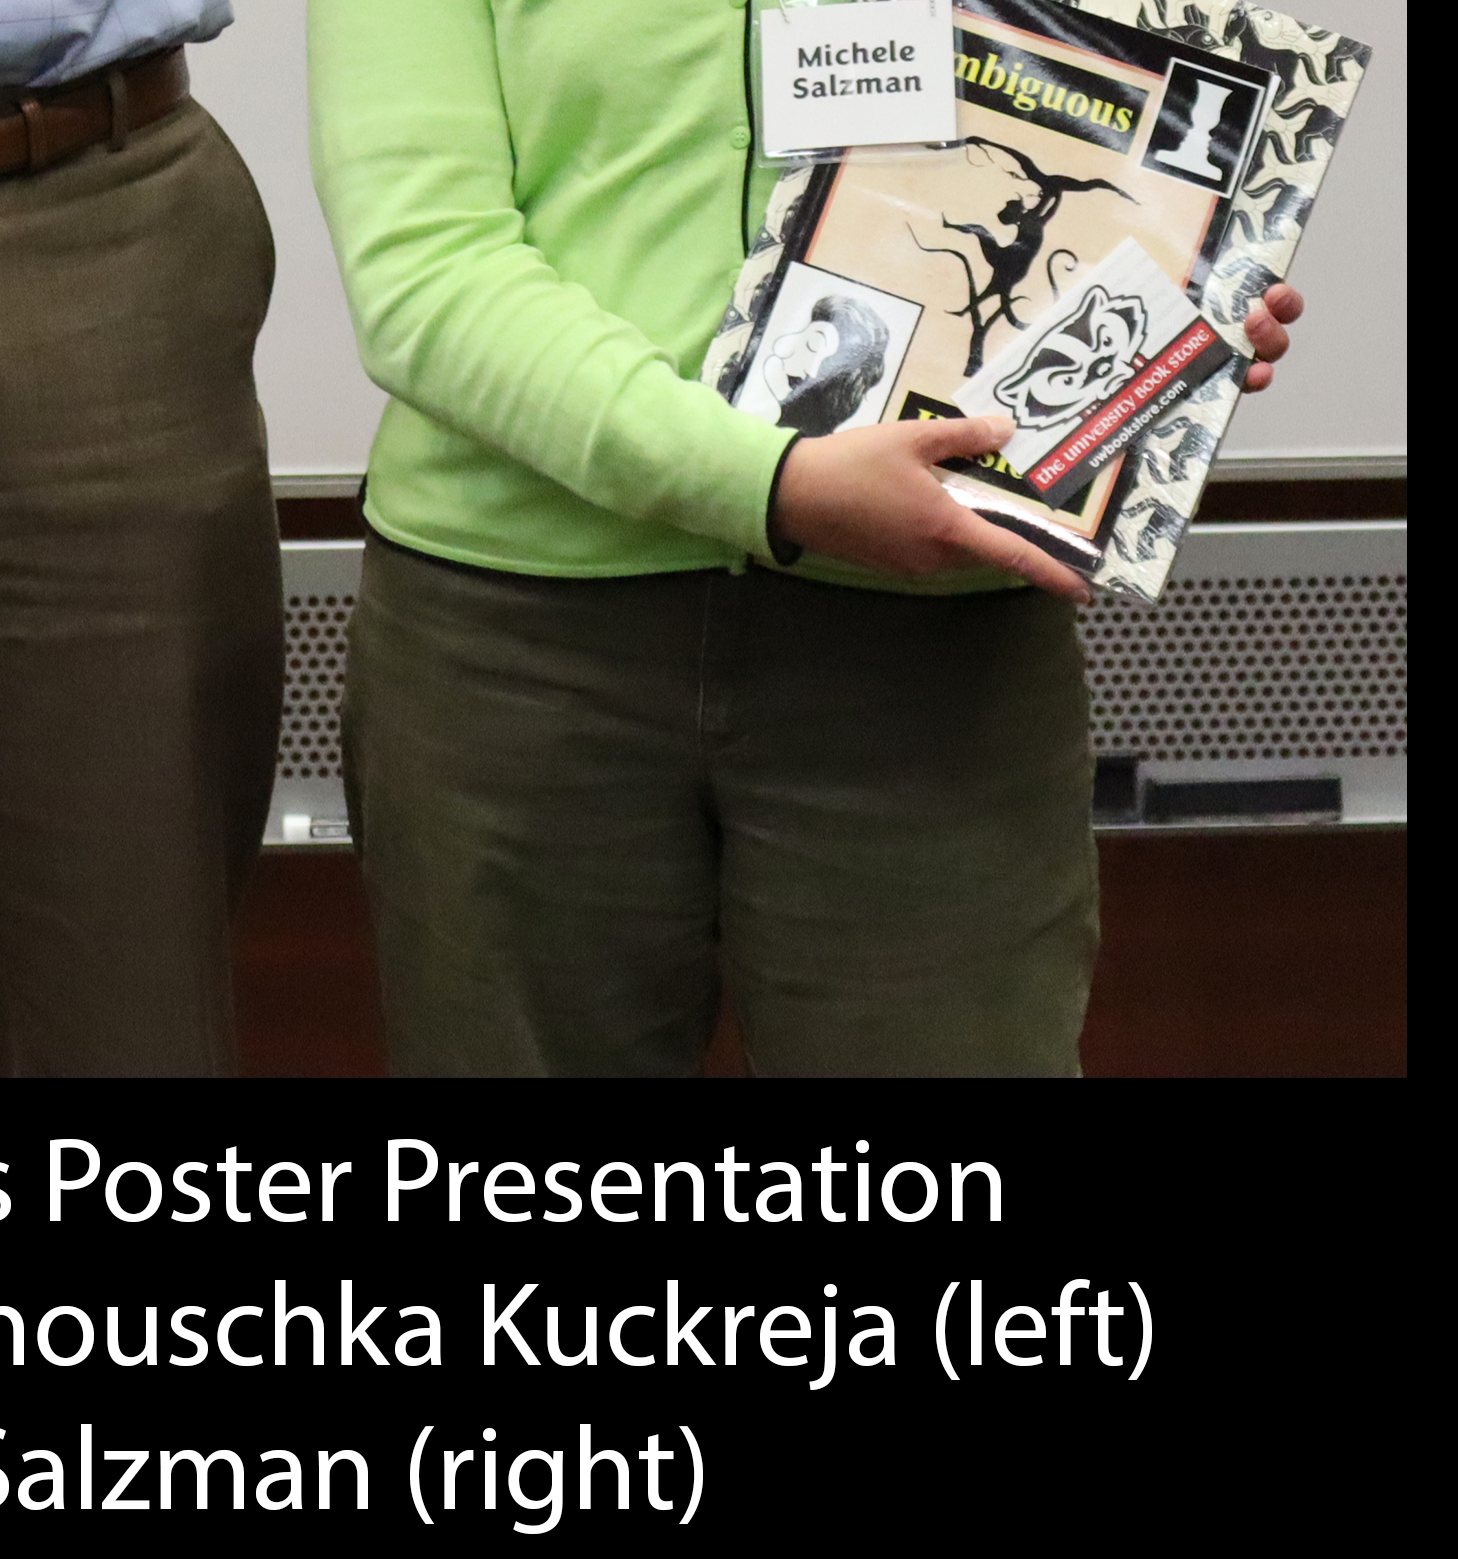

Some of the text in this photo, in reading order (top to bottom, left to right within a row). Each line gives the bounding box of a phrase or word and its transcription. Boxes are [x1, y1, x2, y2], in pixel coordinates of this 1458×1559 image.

[797, 39, 916, 69] Michele
[792, 71, 923, 100] Salzman
[955, 51, 1134, 134] mbiguous
[1088, 378, 1188, 469] uwbookstore.com
